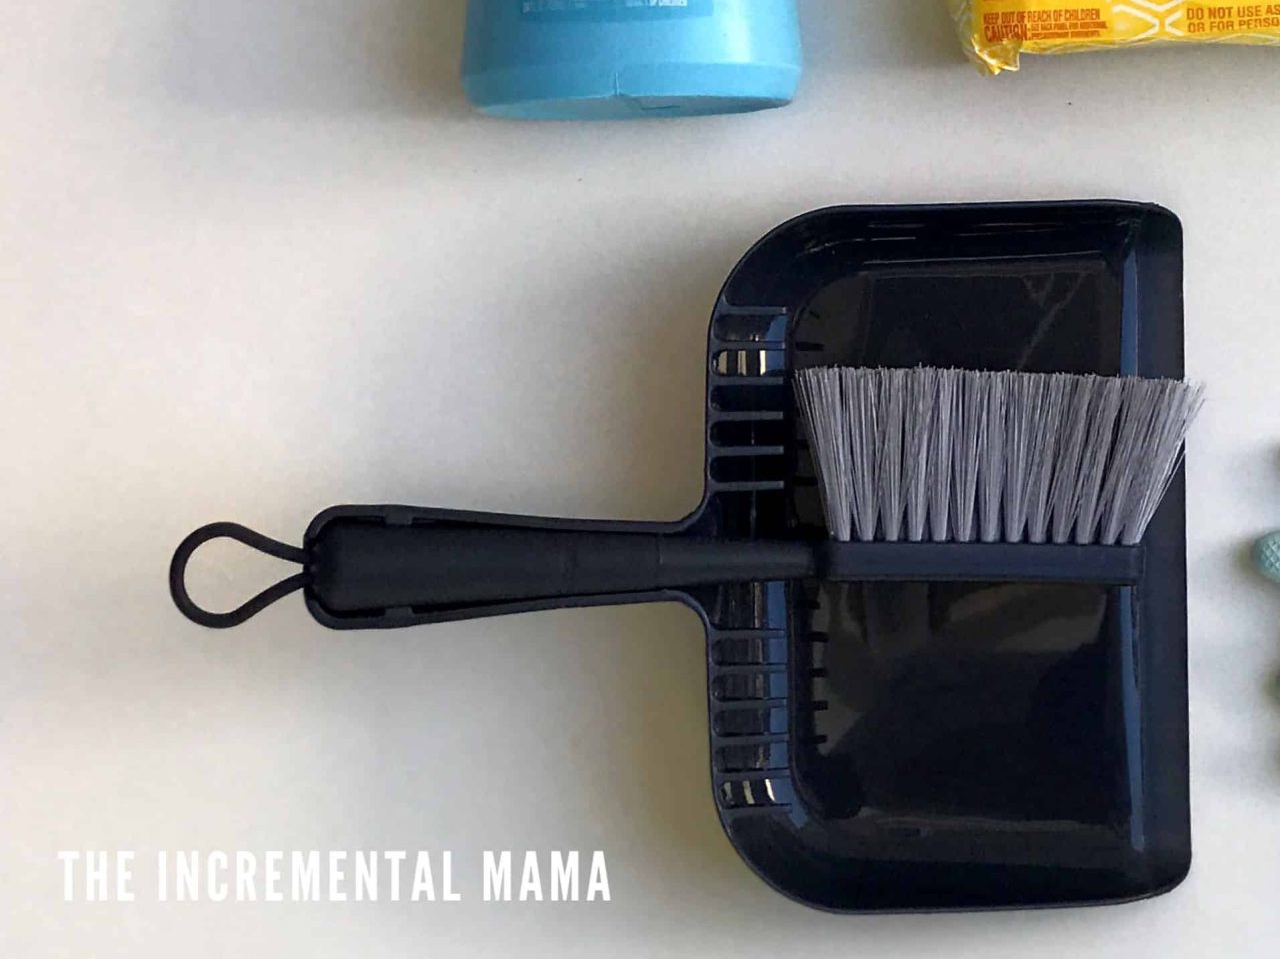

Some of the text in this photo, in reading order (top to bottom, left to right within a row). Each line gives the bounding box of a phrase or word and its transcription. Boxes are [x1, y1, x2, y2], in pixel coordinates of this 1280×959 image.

[984, 8, 1100, 25] KEEP OUT OF REACH OF CHILDREN
[1187, 8, 1204, 20] DO
[1208, 7, 1233, 20] NOT
[1237, 5, 1262, 18] USE
[1188, 22, 1205, 33] OR
[1210, 20, 1235, 32] FOR
